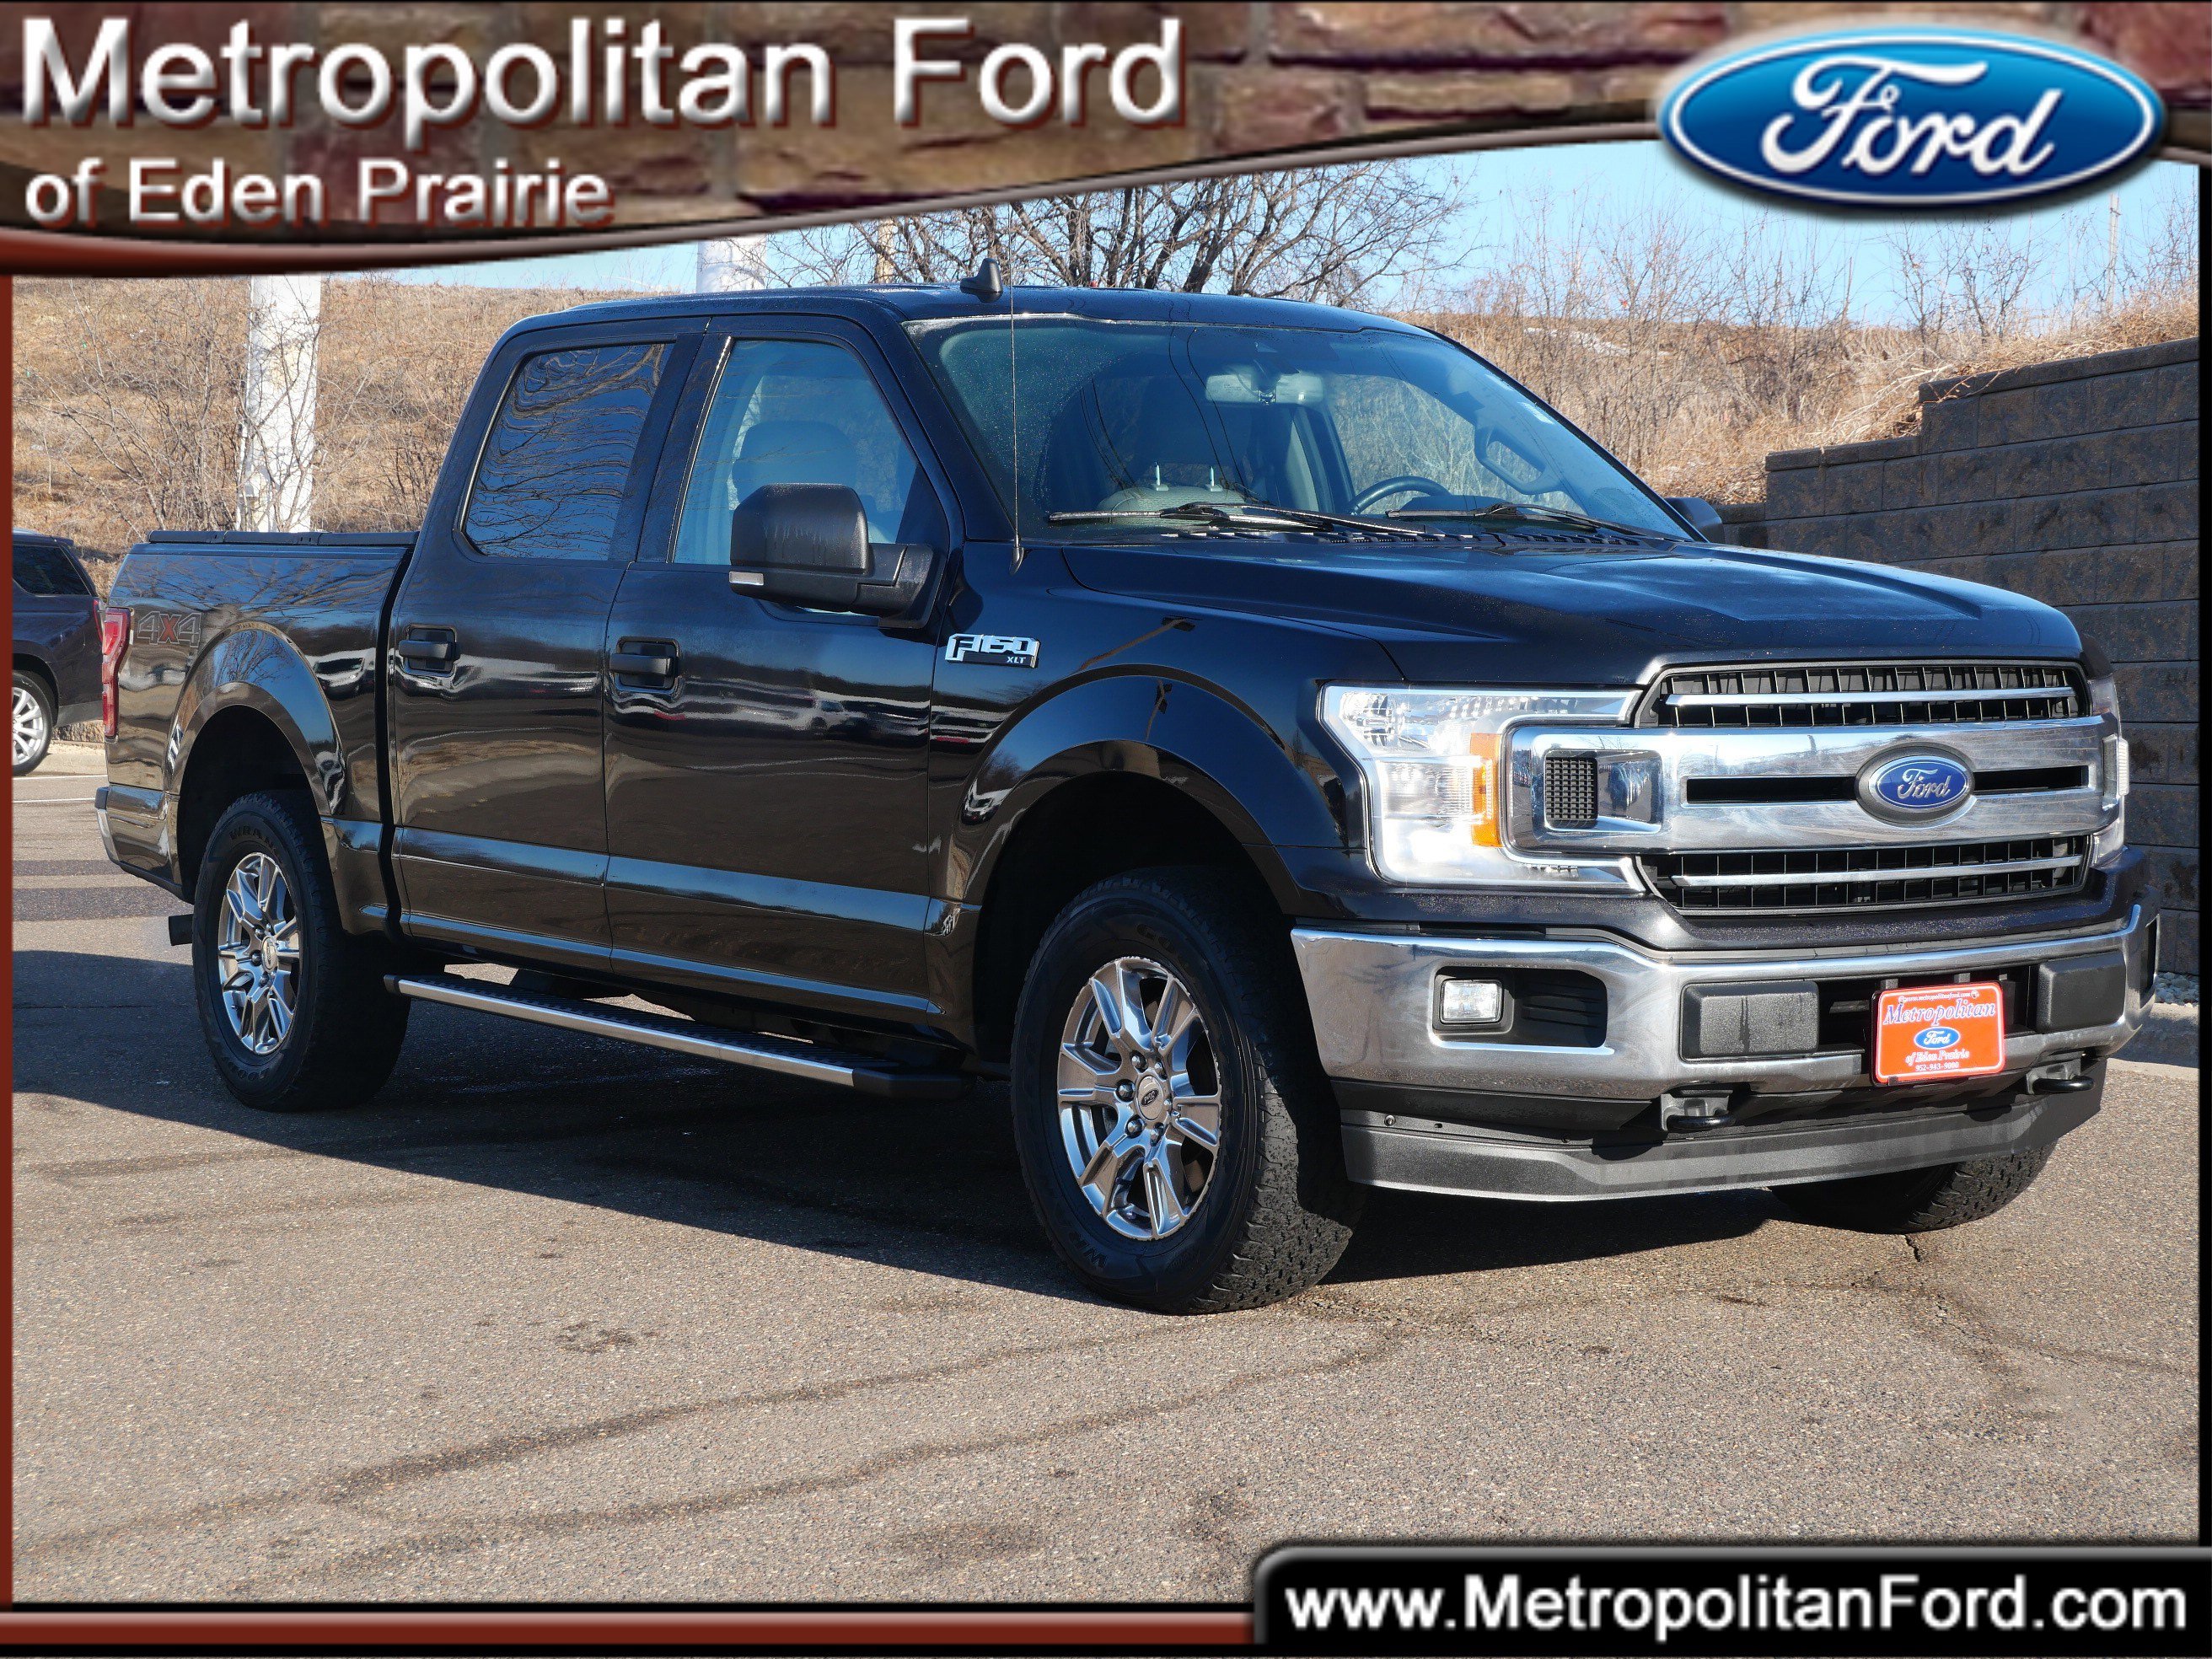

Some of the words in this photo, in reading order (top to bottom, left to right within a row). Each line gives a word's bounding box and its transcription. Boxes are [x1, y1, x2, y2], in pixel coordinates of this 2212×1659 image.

[1007, 656, 1026, 664] XLT
[1897, 768, 1952, 800] Ford
[1883, 998, 1995, 1026] Metropolitan
[1924, 1031, 1951, 1044] Ford
[1905, 1052, 1917, 1066] of
[1915, 1051, 1937, 1063] Eden
[1939, 1049, 1969, 1060] Prairie
